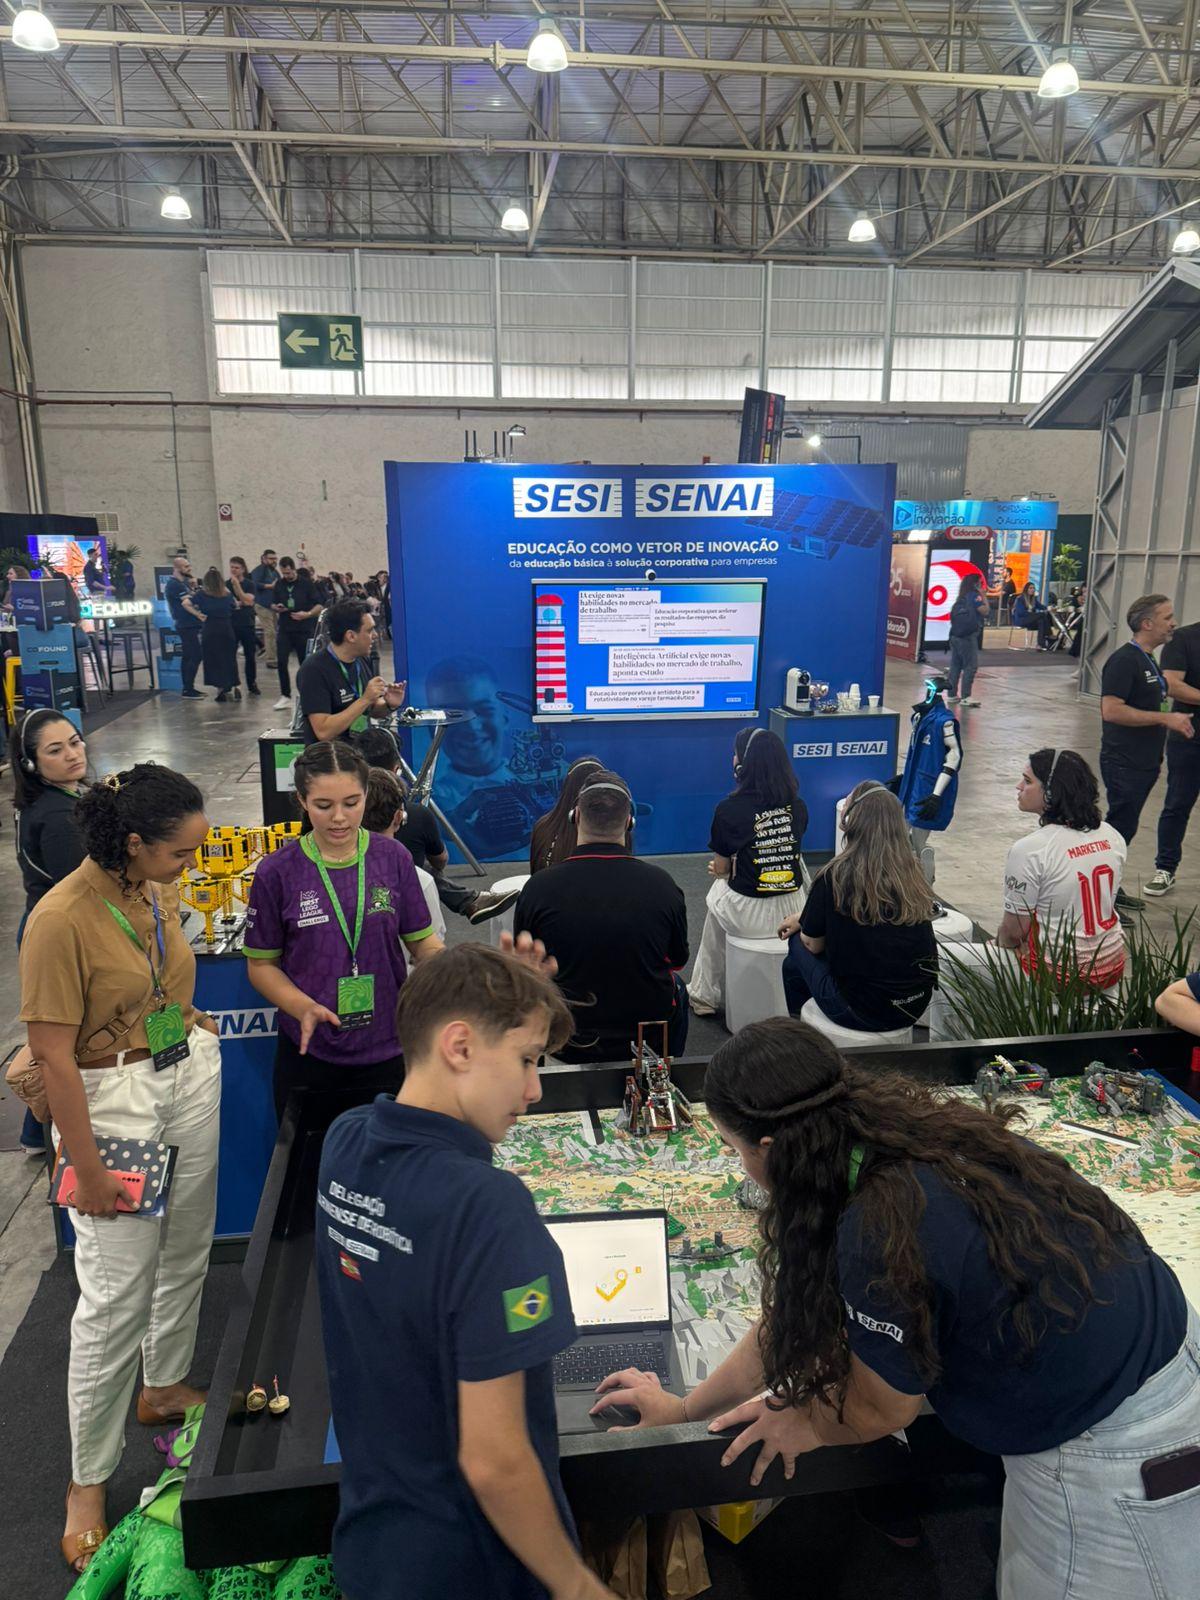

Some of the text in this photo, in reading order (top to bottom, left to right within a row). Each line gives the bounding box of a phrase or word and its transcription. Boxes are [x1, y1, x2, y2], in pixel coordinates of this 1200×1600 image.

[524, 483, 763, 512] SESI SENAI
[508, 538, 779, 556] EDUCAÇÃO COMO VETOR DE INOVAÇÃO
[509, 559, 522, 568] da
[524, 558, 572, 569] educação
[574, 558, 605, 567] básica
[616, 558, 652, 568] solução
[655, 558, 709, 568] corporativa
[711, 558, 732, 567] para
[734, 557, 778, 566] empresas
[588, 592, 605, 600] exige
[80, 600, 152, 618] OFOUND
[887, 620, 906, 634] ldorado
[613, 652, 656, 660] Inteligência
[690, 652, 709, 660] exige
[710, 660, 742, 668] trabalho,
[613, 668, 664, 678] aponta estudo
[797, 742, 884, 756] SESI SENAI
[768, 826, 791, 836] Brasil
[1067, 839, 1111, 859] MARKETING
[757, 854, 794, 864] melhores
[1076, 864, 1118, 936] 10
[212, 1012, 278, 1036] NAI
[861, 1315, 901, 1338] SENAI
